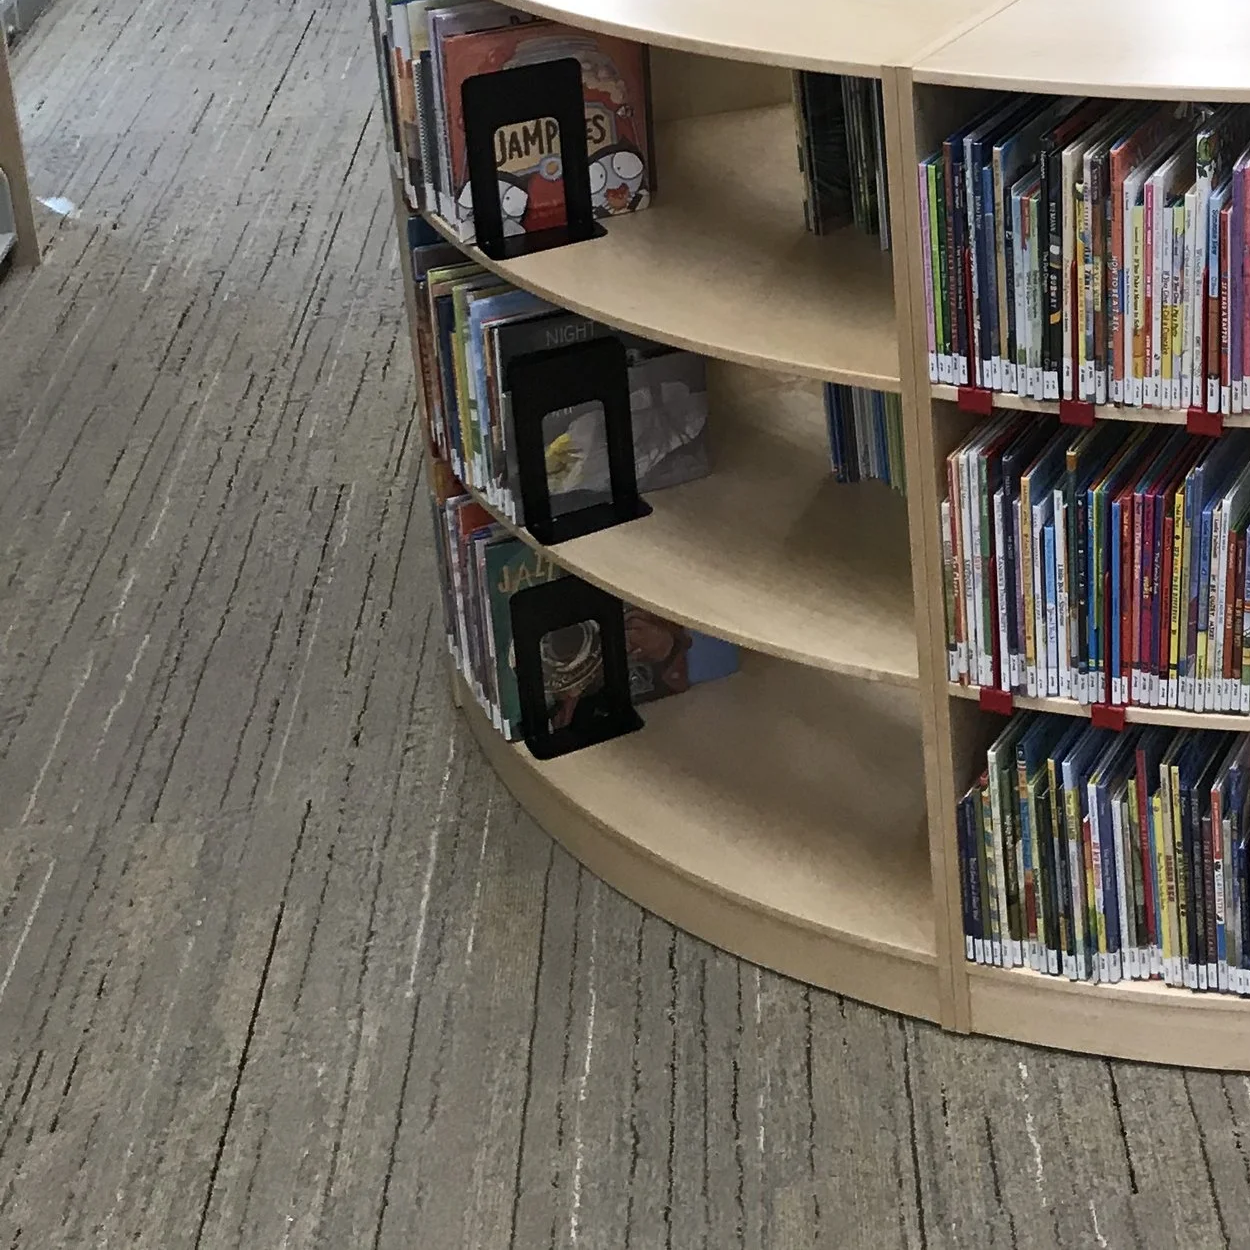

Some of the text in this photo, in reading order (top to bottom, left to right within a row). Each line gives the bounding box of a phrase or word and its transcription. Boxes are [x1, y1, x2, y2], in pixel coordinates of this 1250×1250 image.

[1211, 209, 1219, 240] Someone
[1111, 256, 1119, 275] HOW
[1049, 274, 1058, 309] SUBWAY
